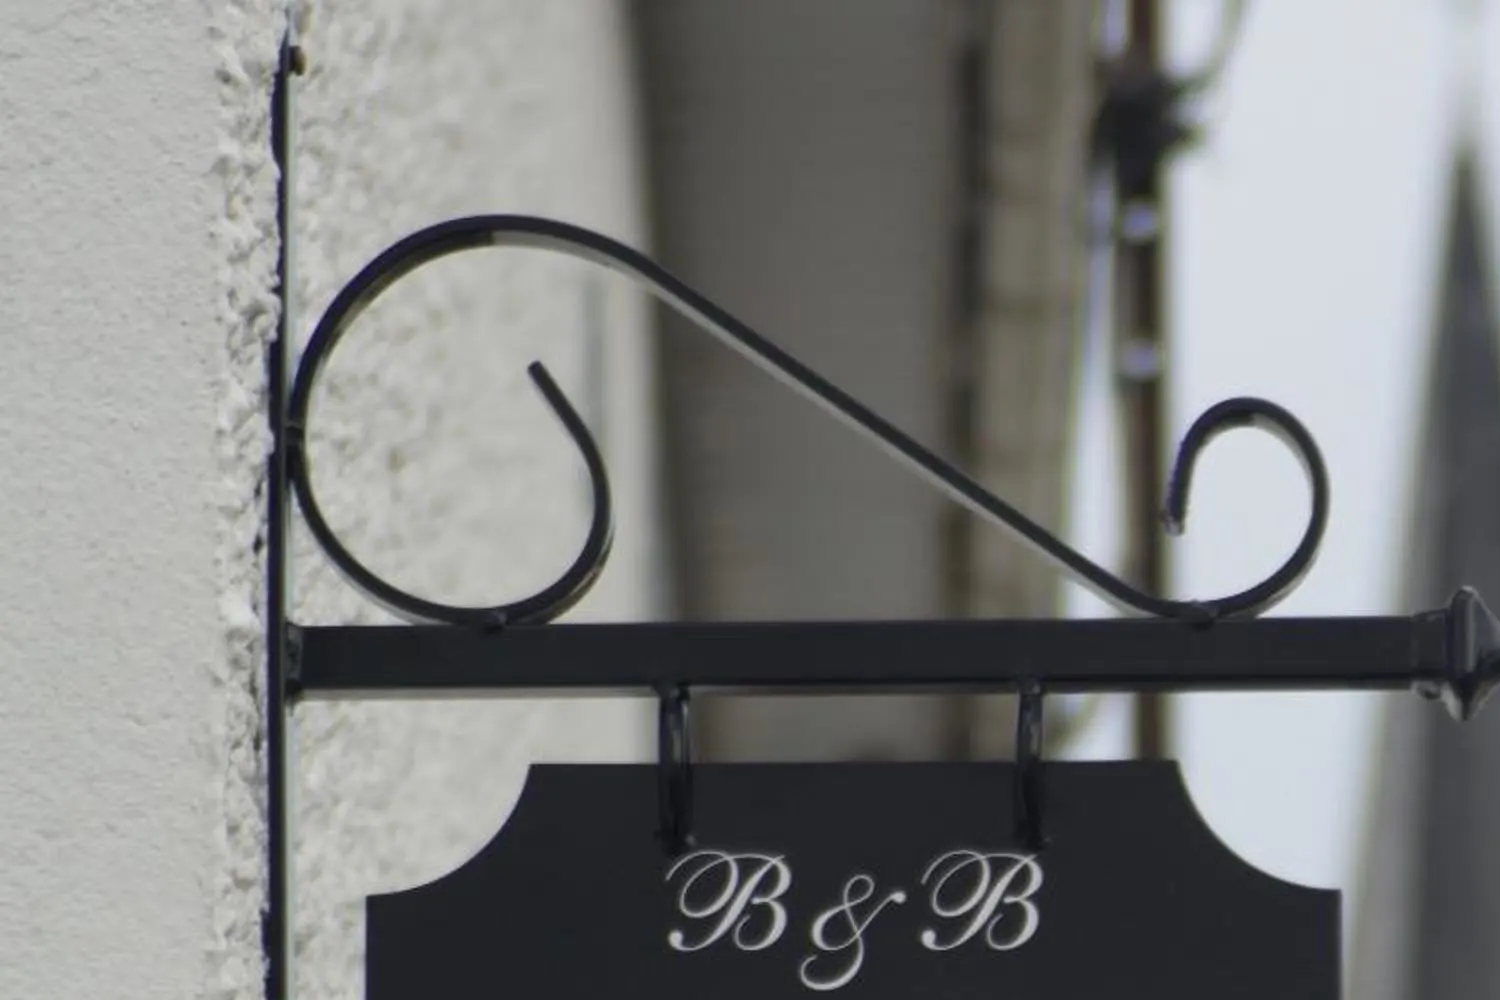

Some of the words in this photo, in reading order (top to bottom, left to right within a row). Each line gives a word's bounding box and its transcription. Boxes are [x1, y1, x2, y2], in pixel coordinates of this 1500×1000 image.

[667, 851, 792, 952] B
[800, 875, 907, 991] &
[921, 850, 1044, 951] B
